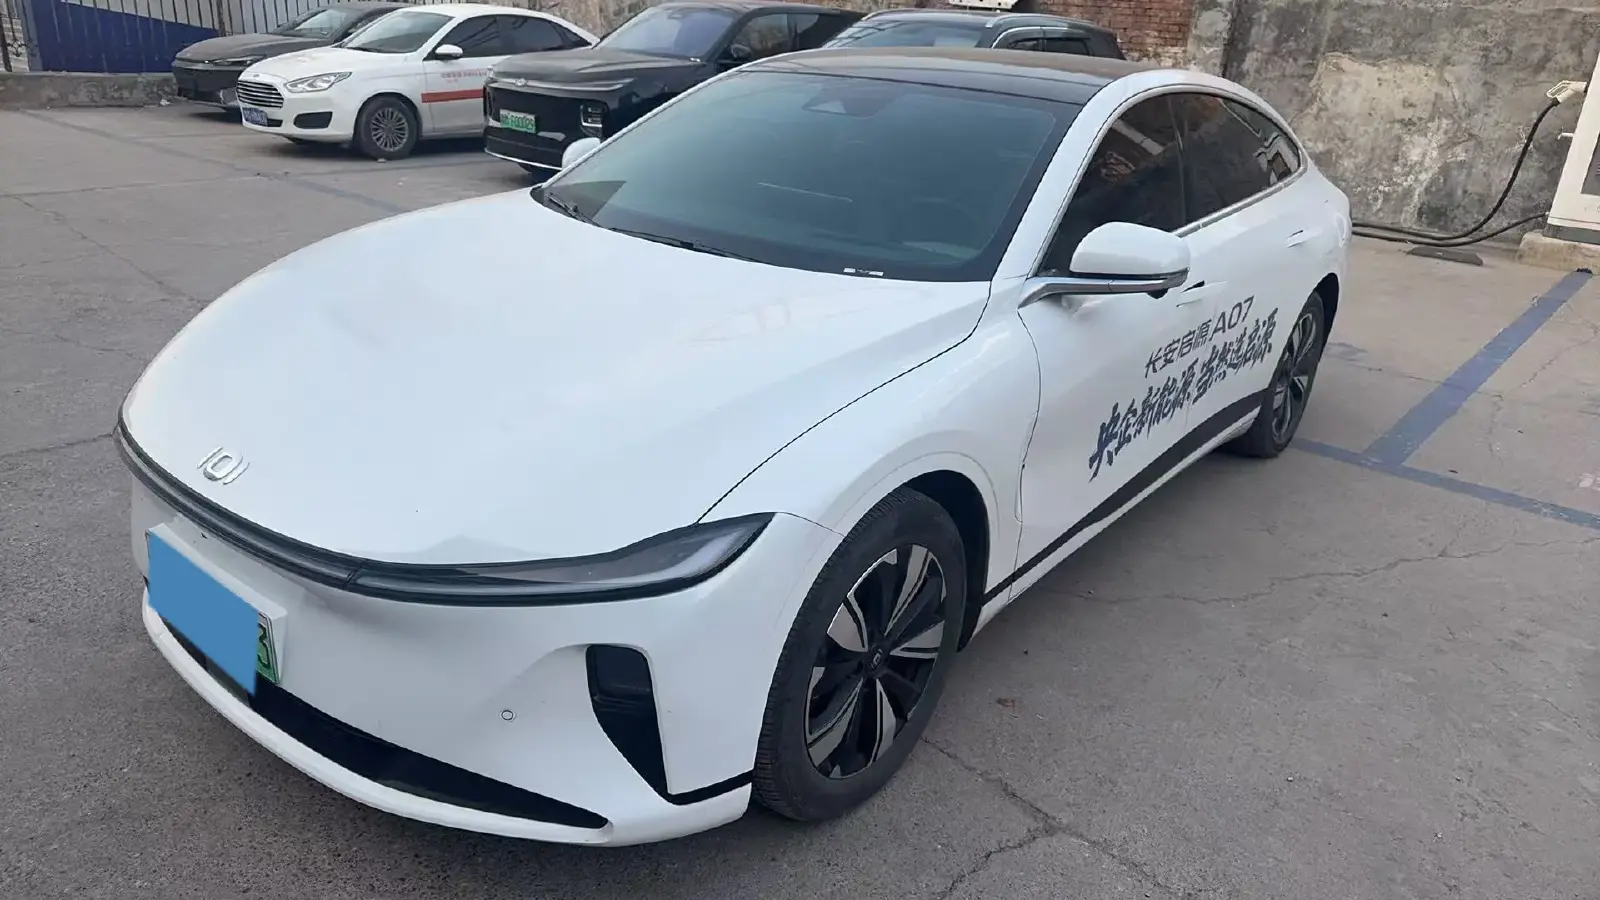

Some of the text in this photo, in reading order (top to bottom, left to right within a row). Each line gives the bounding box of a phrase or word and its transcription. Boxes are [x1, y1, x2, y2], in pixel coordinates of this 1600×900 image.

[1145, 296, 1255, 378] 长安启源 A07
[1089, 358, 1199, 482] 央企新能源
